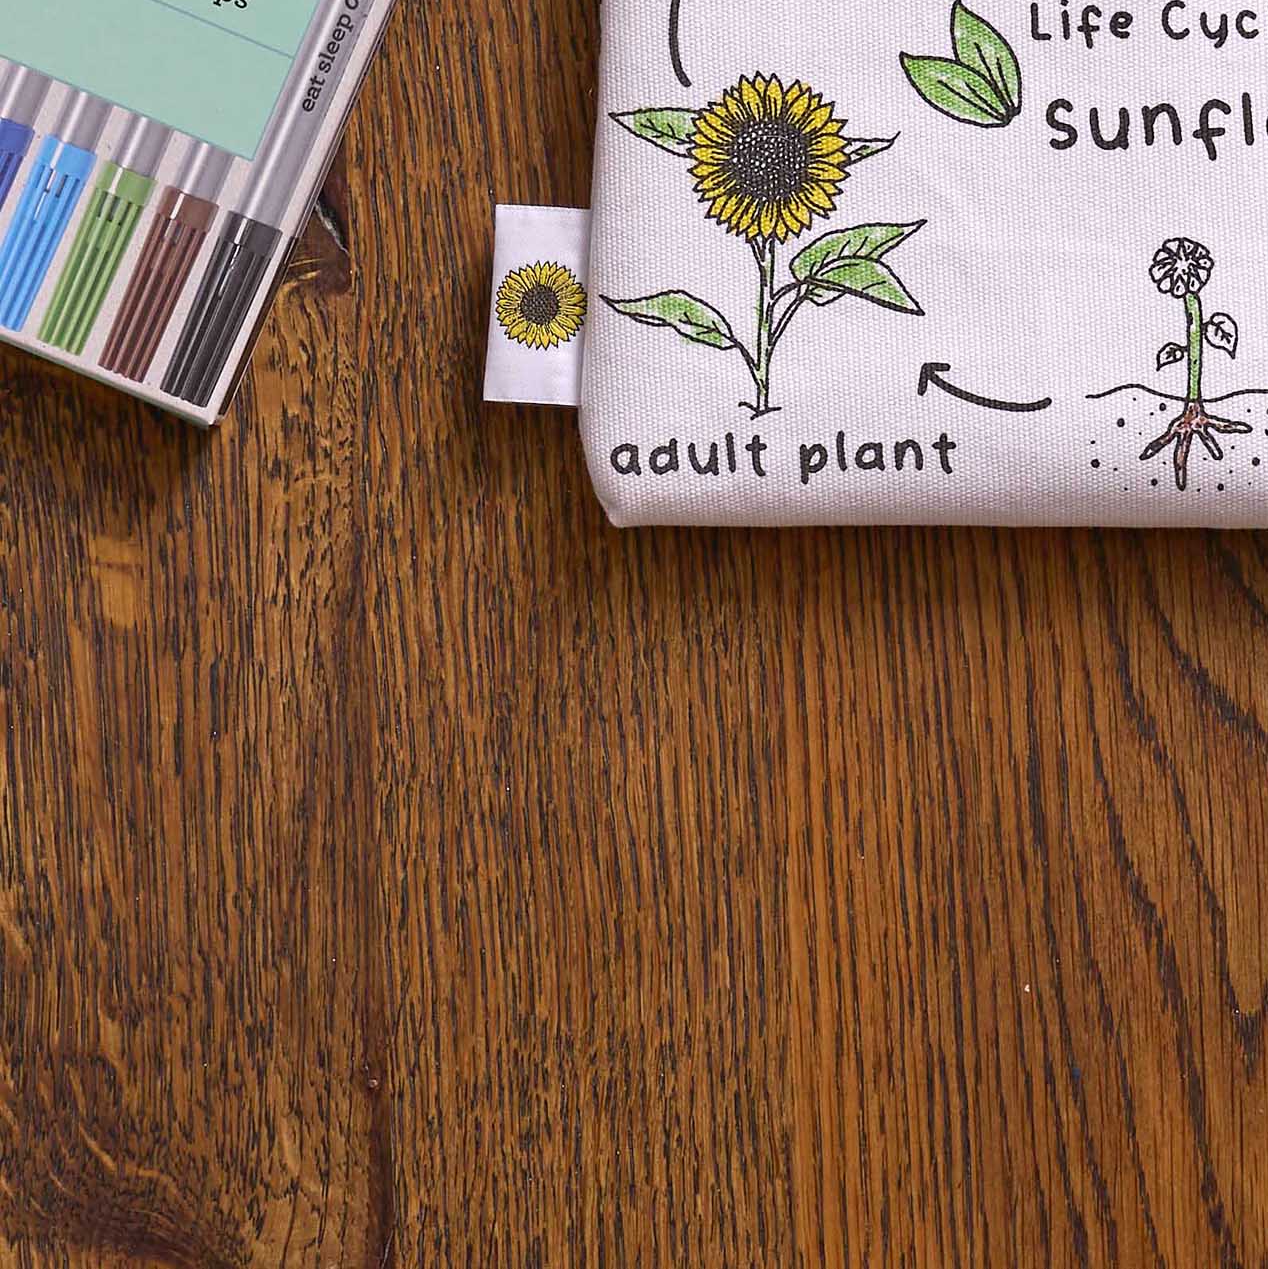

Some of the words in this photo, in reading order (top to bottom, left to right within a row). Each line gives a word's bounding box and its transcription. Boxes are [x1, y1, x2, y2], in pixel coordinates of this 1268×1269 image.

[301, 75, 326, 112] eat
[318, 13, 354, 74] sleep
[609, 432, 768, 477] adult
[799, 430, 957, 485] plant
